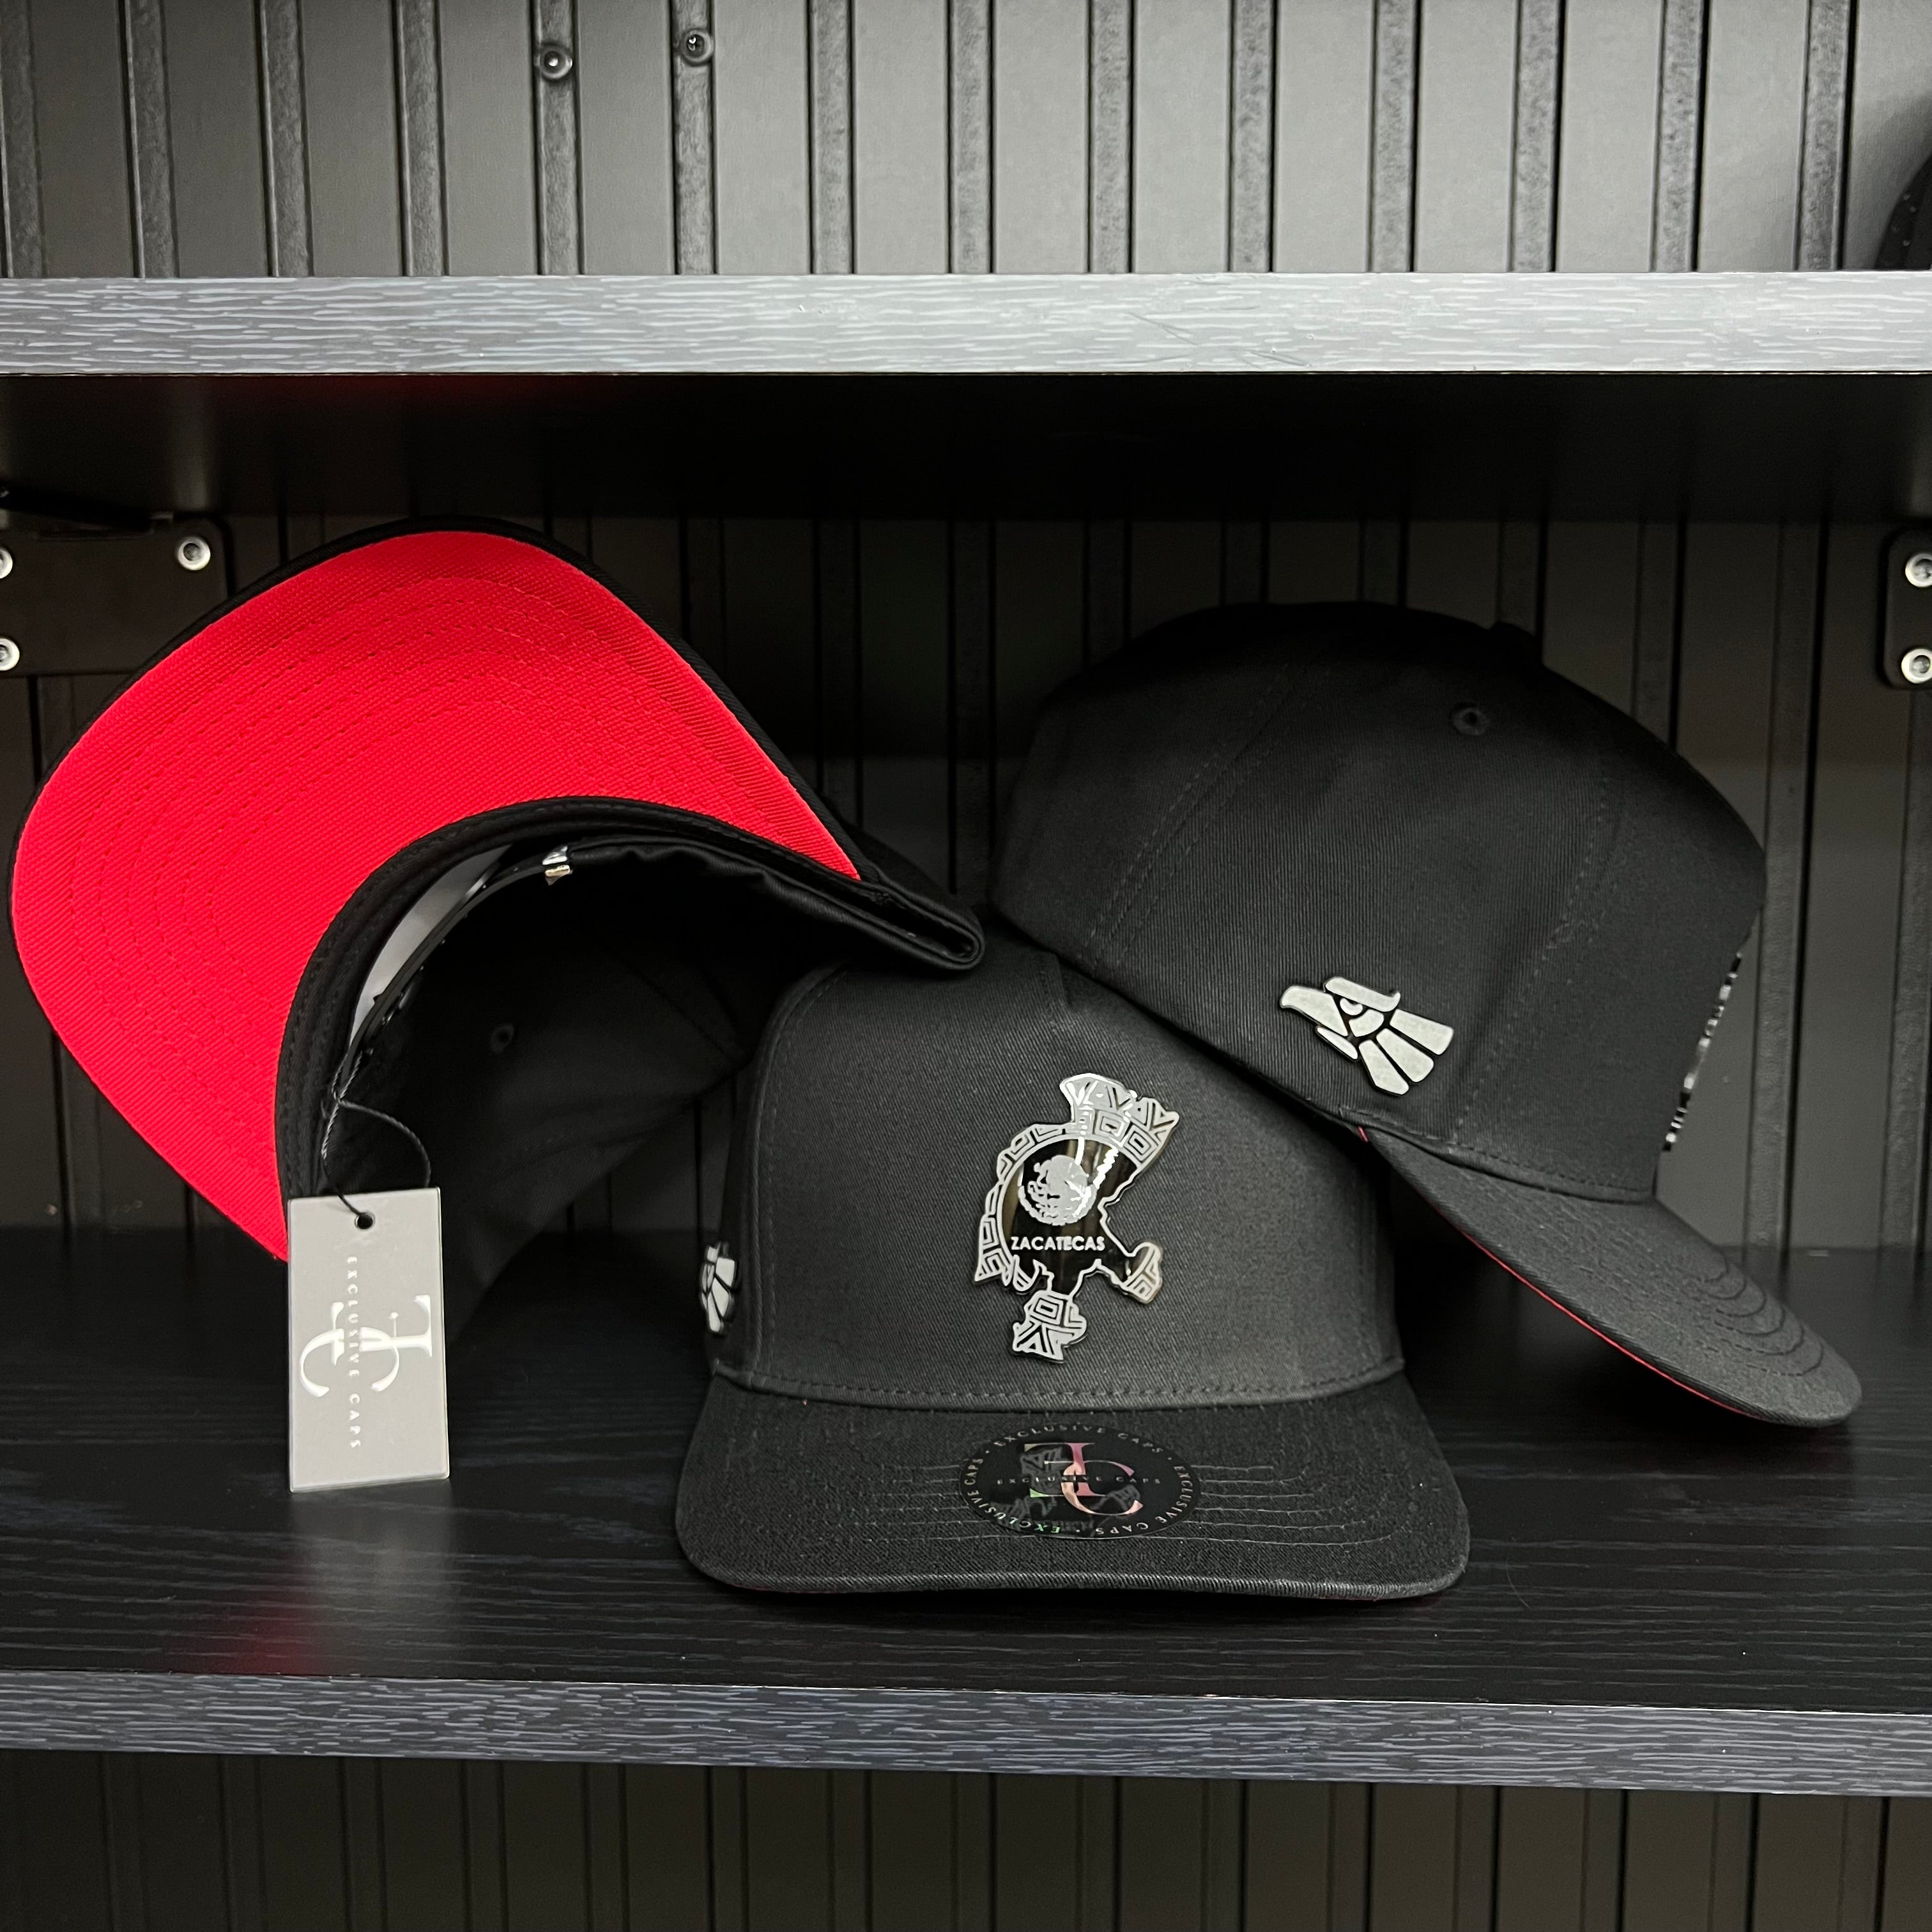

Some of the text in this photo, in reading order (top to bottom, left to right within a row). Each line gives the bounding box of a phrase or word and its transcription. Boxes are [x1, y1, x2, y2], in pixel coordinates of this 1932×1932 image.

[1011, 1237, 1105, 1251] ZACATECAS
[347, 1256, 360, 1448] EXCLUSIVE CAPS
[993, 1425, 1105, 1446] EXCLUSIVE
[965, 1457, 1061, 1533] EXCLUSIVE CAPS
[1095, 1466, 1193, 1535] EXCLUSIVE CAPS
